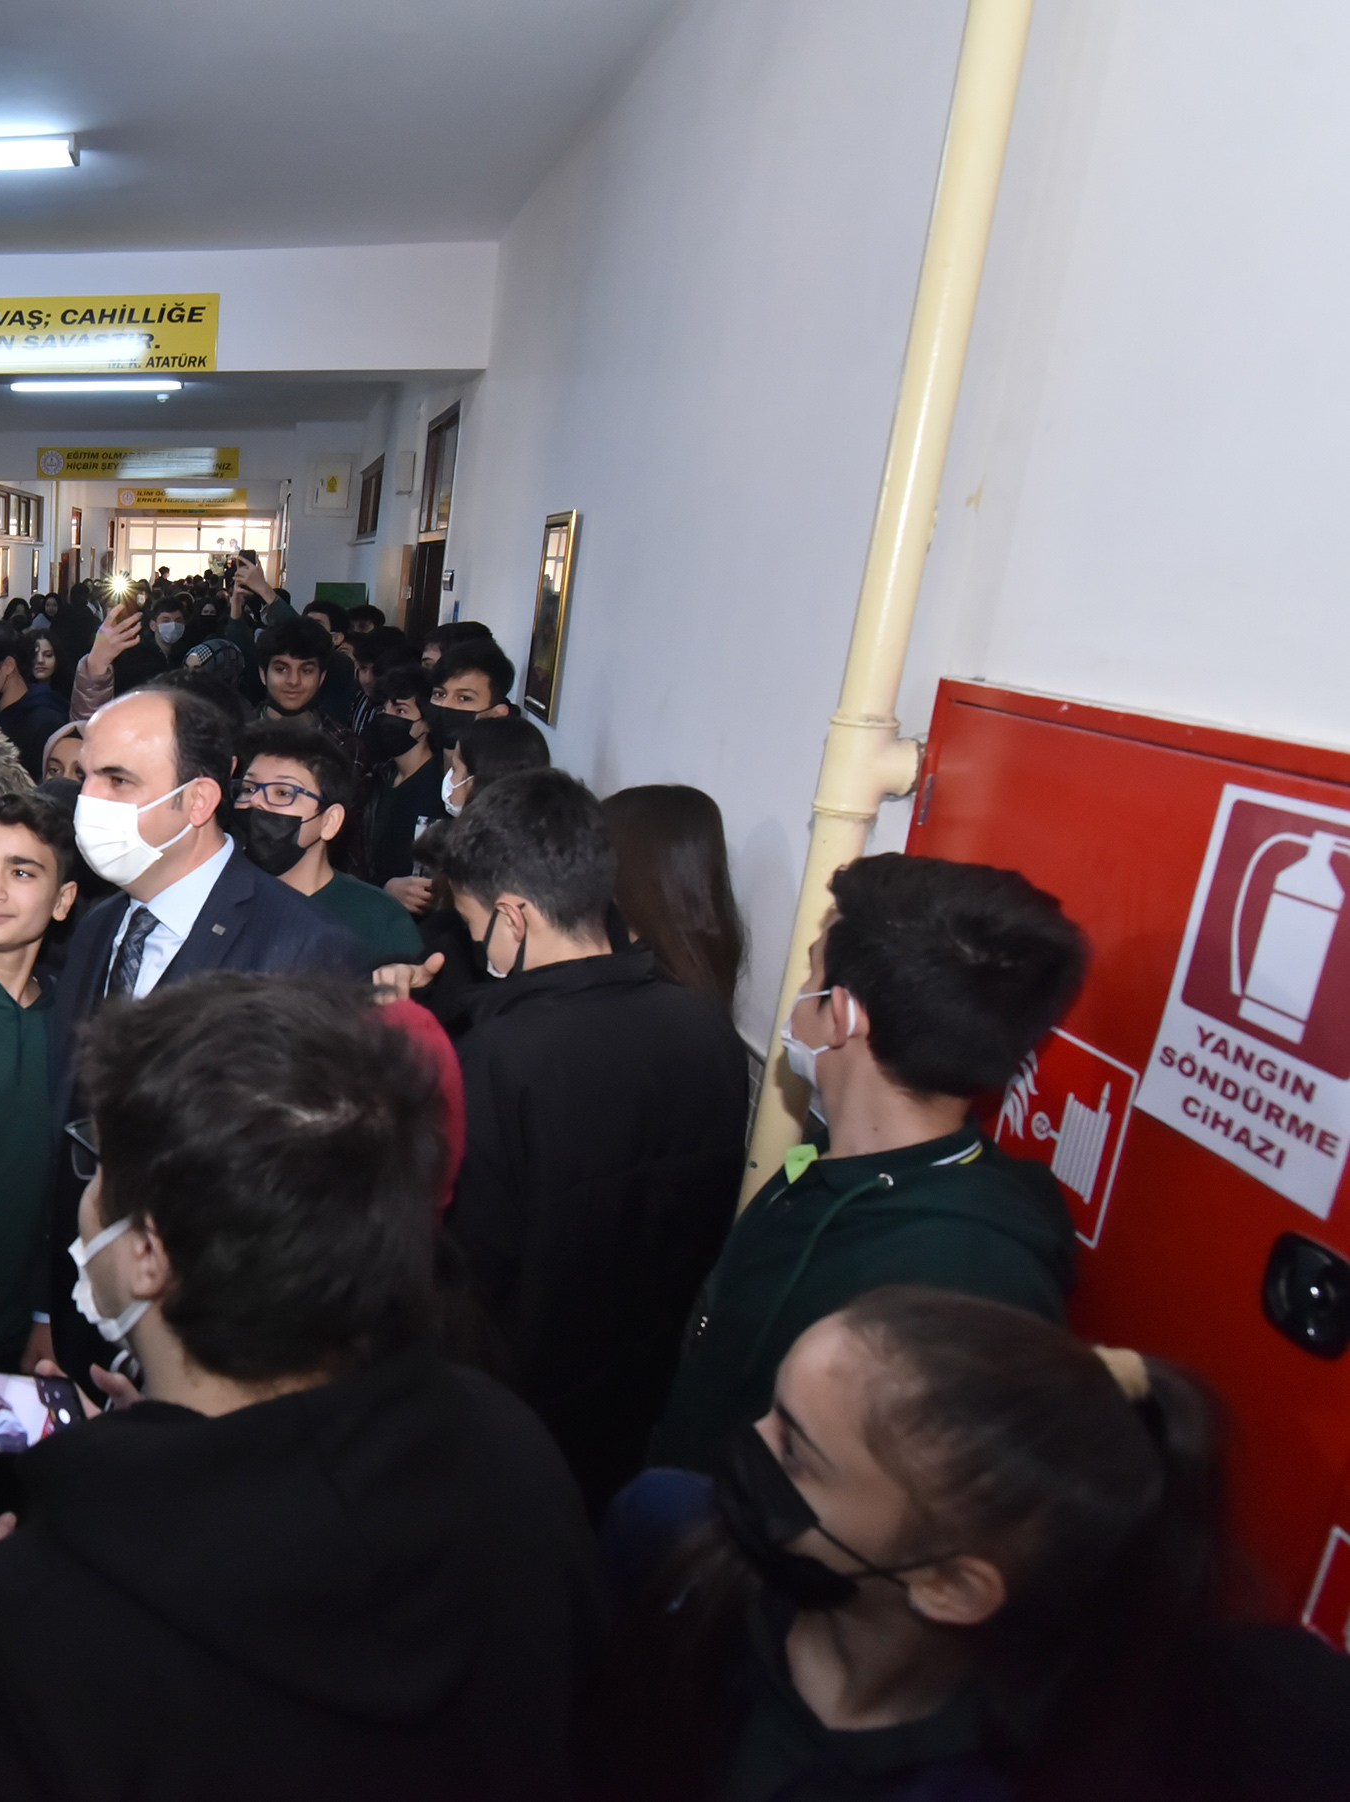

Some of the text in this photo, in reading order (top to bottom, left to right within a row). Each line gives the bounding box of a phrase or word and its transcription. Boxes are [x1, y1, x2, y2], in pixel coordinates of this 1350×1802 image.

[60, 302, 206, 326] CAHİLLİĞE
[145, 353, 207, 368] ATATÜRK
[1197, 1025, 1316, 1103] YANGIN
[1159, 1045, 1340, 1159] SÖNDÜRME
